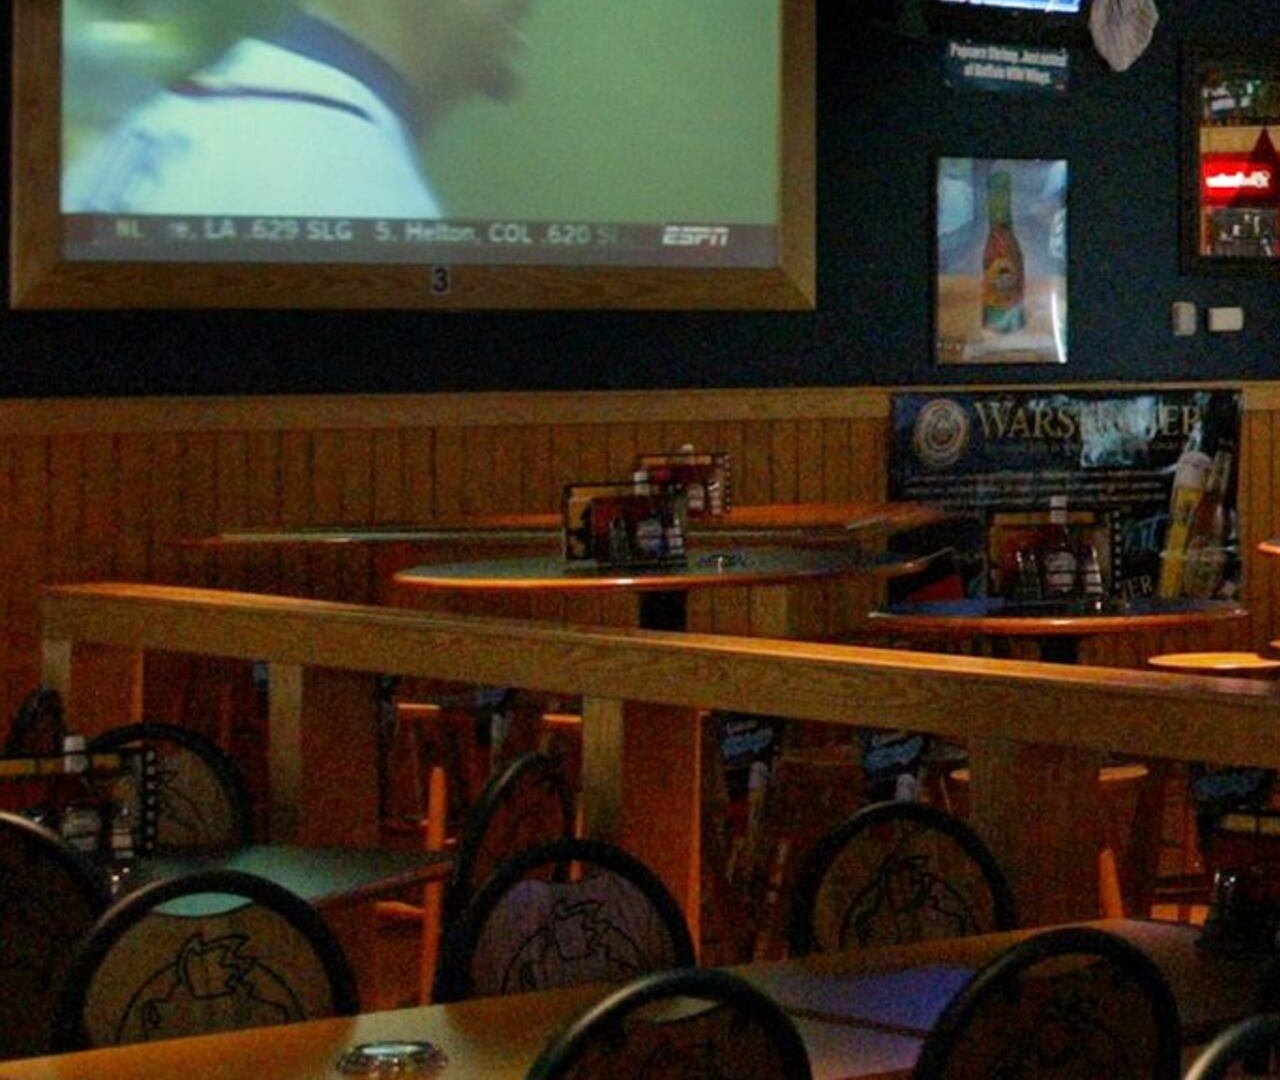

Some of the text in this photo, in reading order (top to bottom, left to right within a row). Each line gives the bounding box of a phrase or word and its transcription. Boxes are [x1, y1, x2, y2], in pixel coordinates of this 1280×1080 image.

[204, 220, 238, 240] LA
[306, 221, 353, 241] SLG
[488, 223, 533, 244] COL
[661, 226, 731, 247] ESPN
[432, 267, 448, 294] 3
